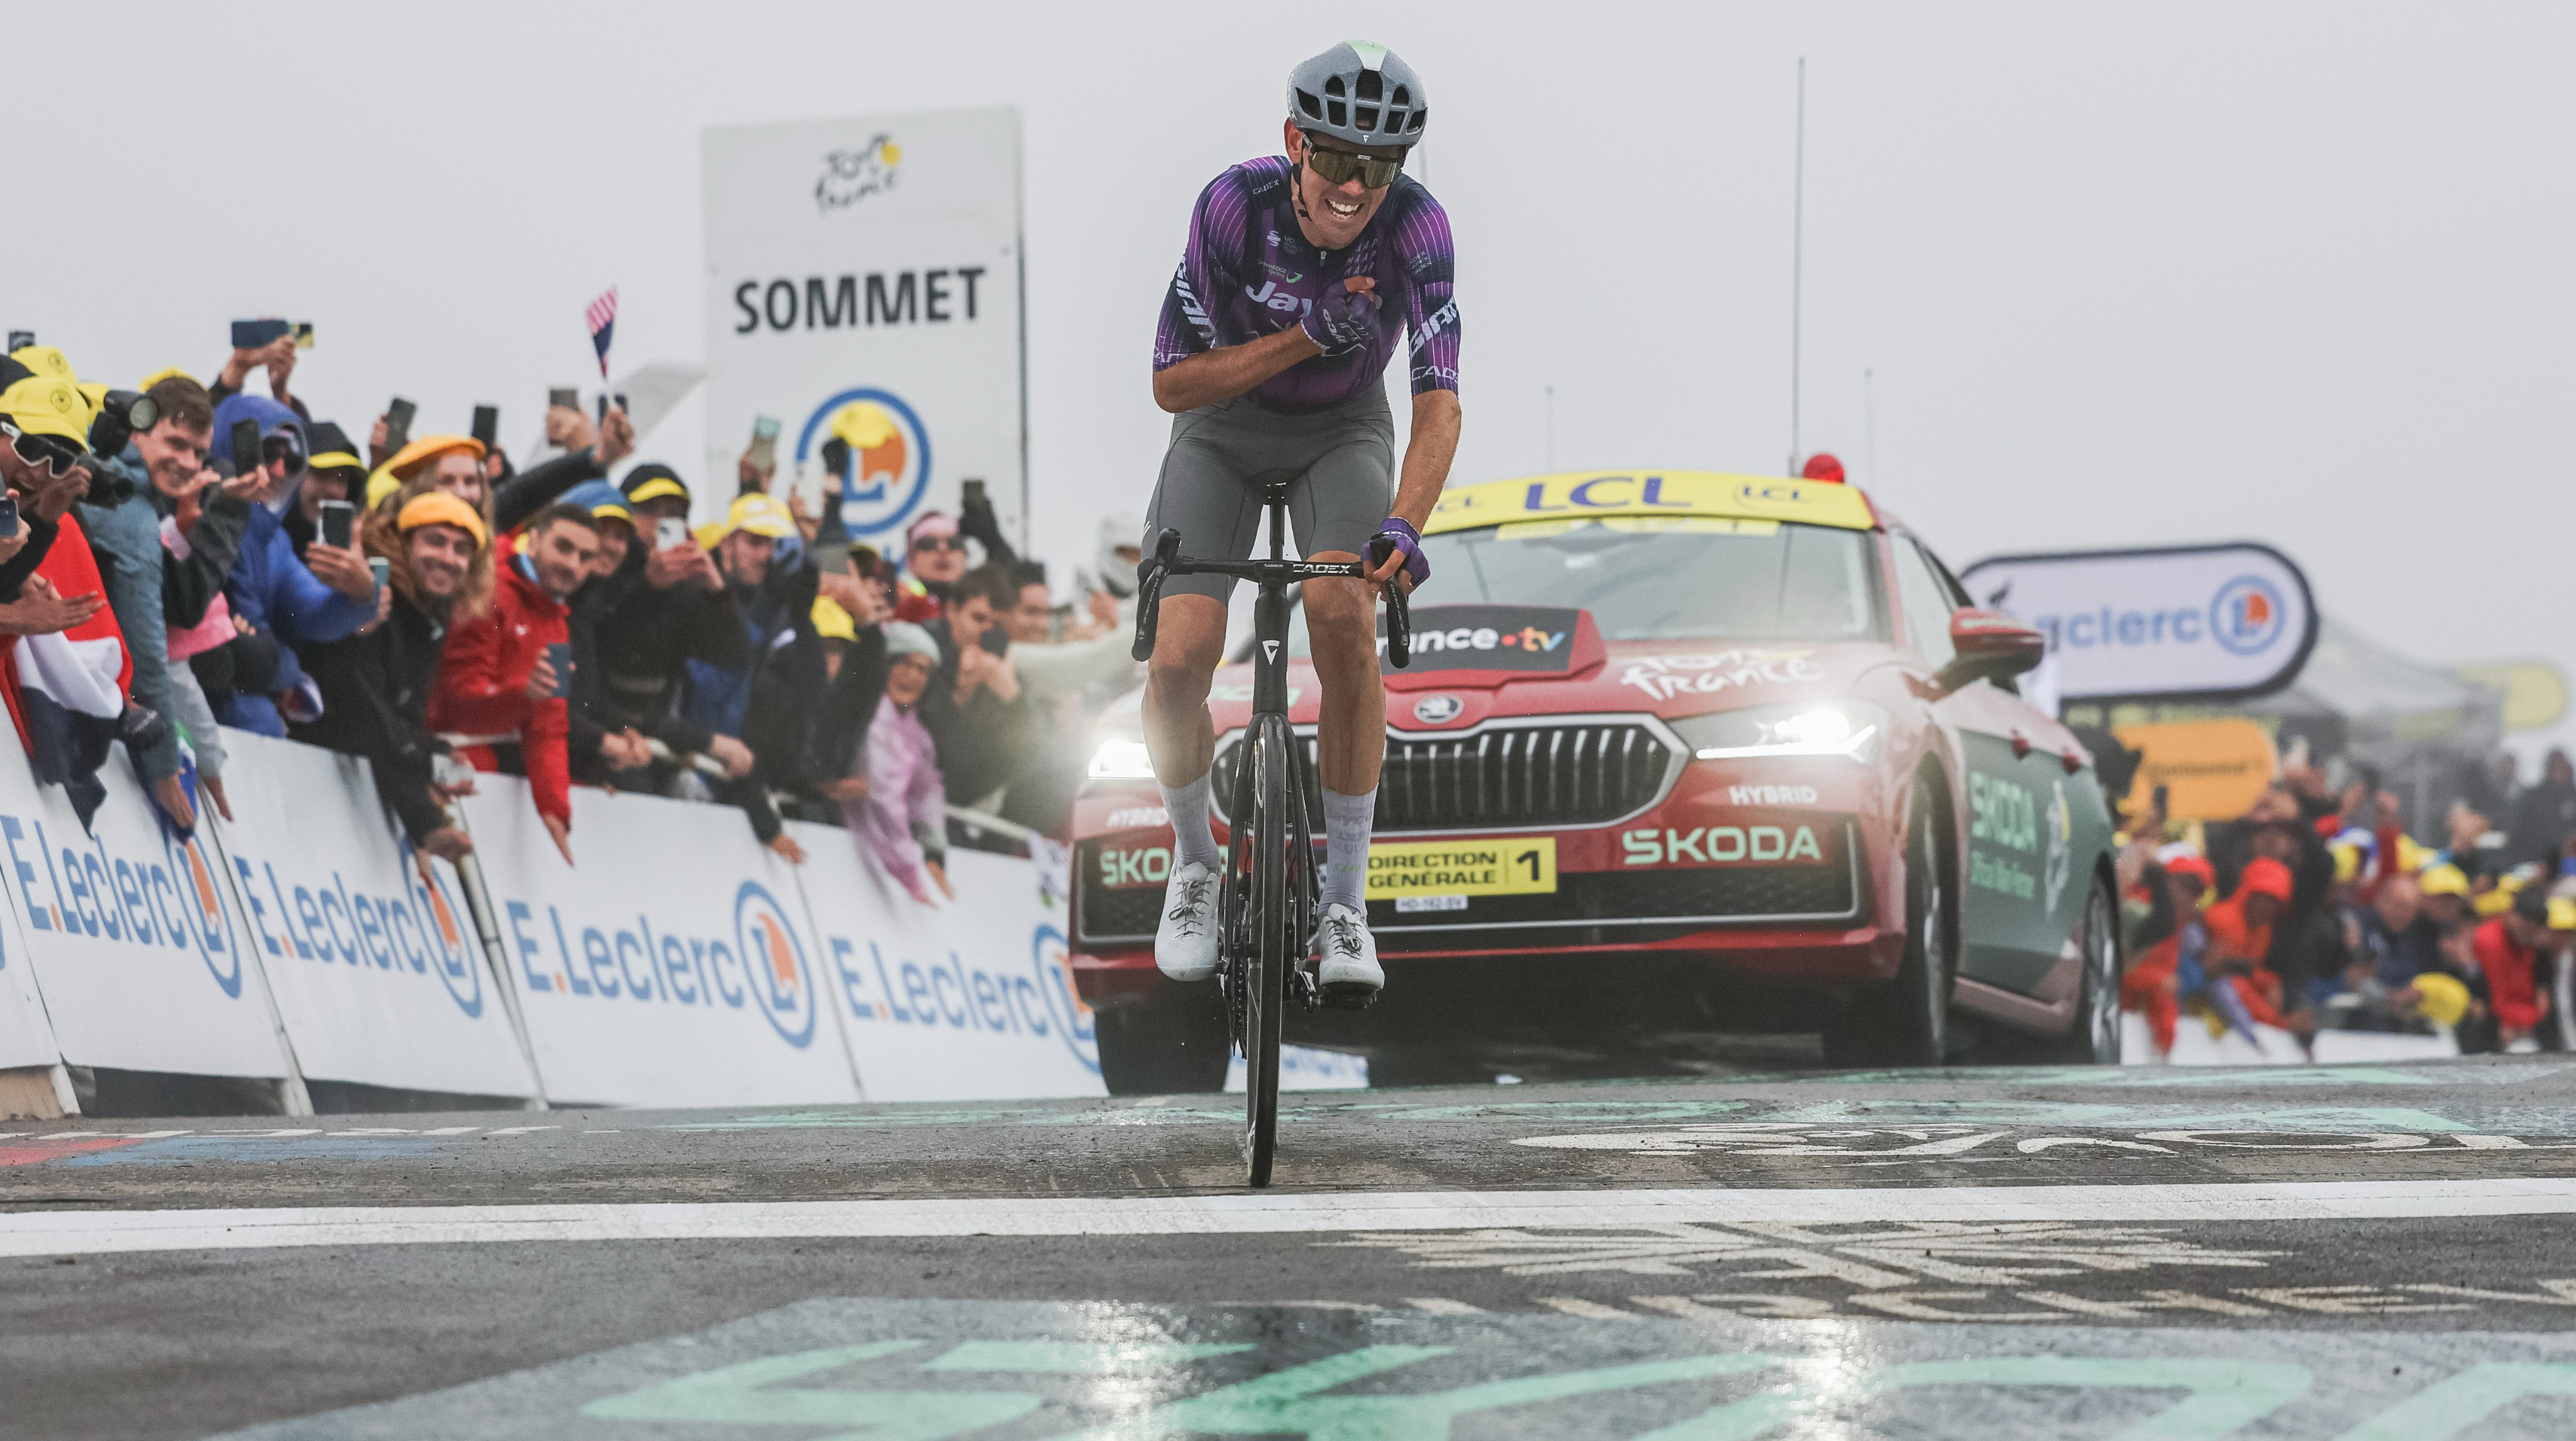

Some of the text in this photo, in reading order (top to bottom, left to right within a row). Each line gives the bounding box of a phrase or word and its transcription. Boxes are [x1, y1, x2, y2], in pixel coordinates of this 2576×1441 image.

[735, 267, 986, 334] SOMMET
[1524, 476, 1692, 511] LCL
[1293, 563, 1352, 574] CADEX
[1729, 786, 1818, 805] HYBRID
[1368, 851, 1497, 869] DIRECTION
[1623, 825, 1821, 865] SKODA
[1, 814, 187, 950] E.Leclerc
[1516, 850, 1540, 881] 1
[233, 855, 426, 974] E.Leclerc
[506, 900, 744, 1008] E.Leclerc
[829, 937, 1050, 1038] E.Leclerc
